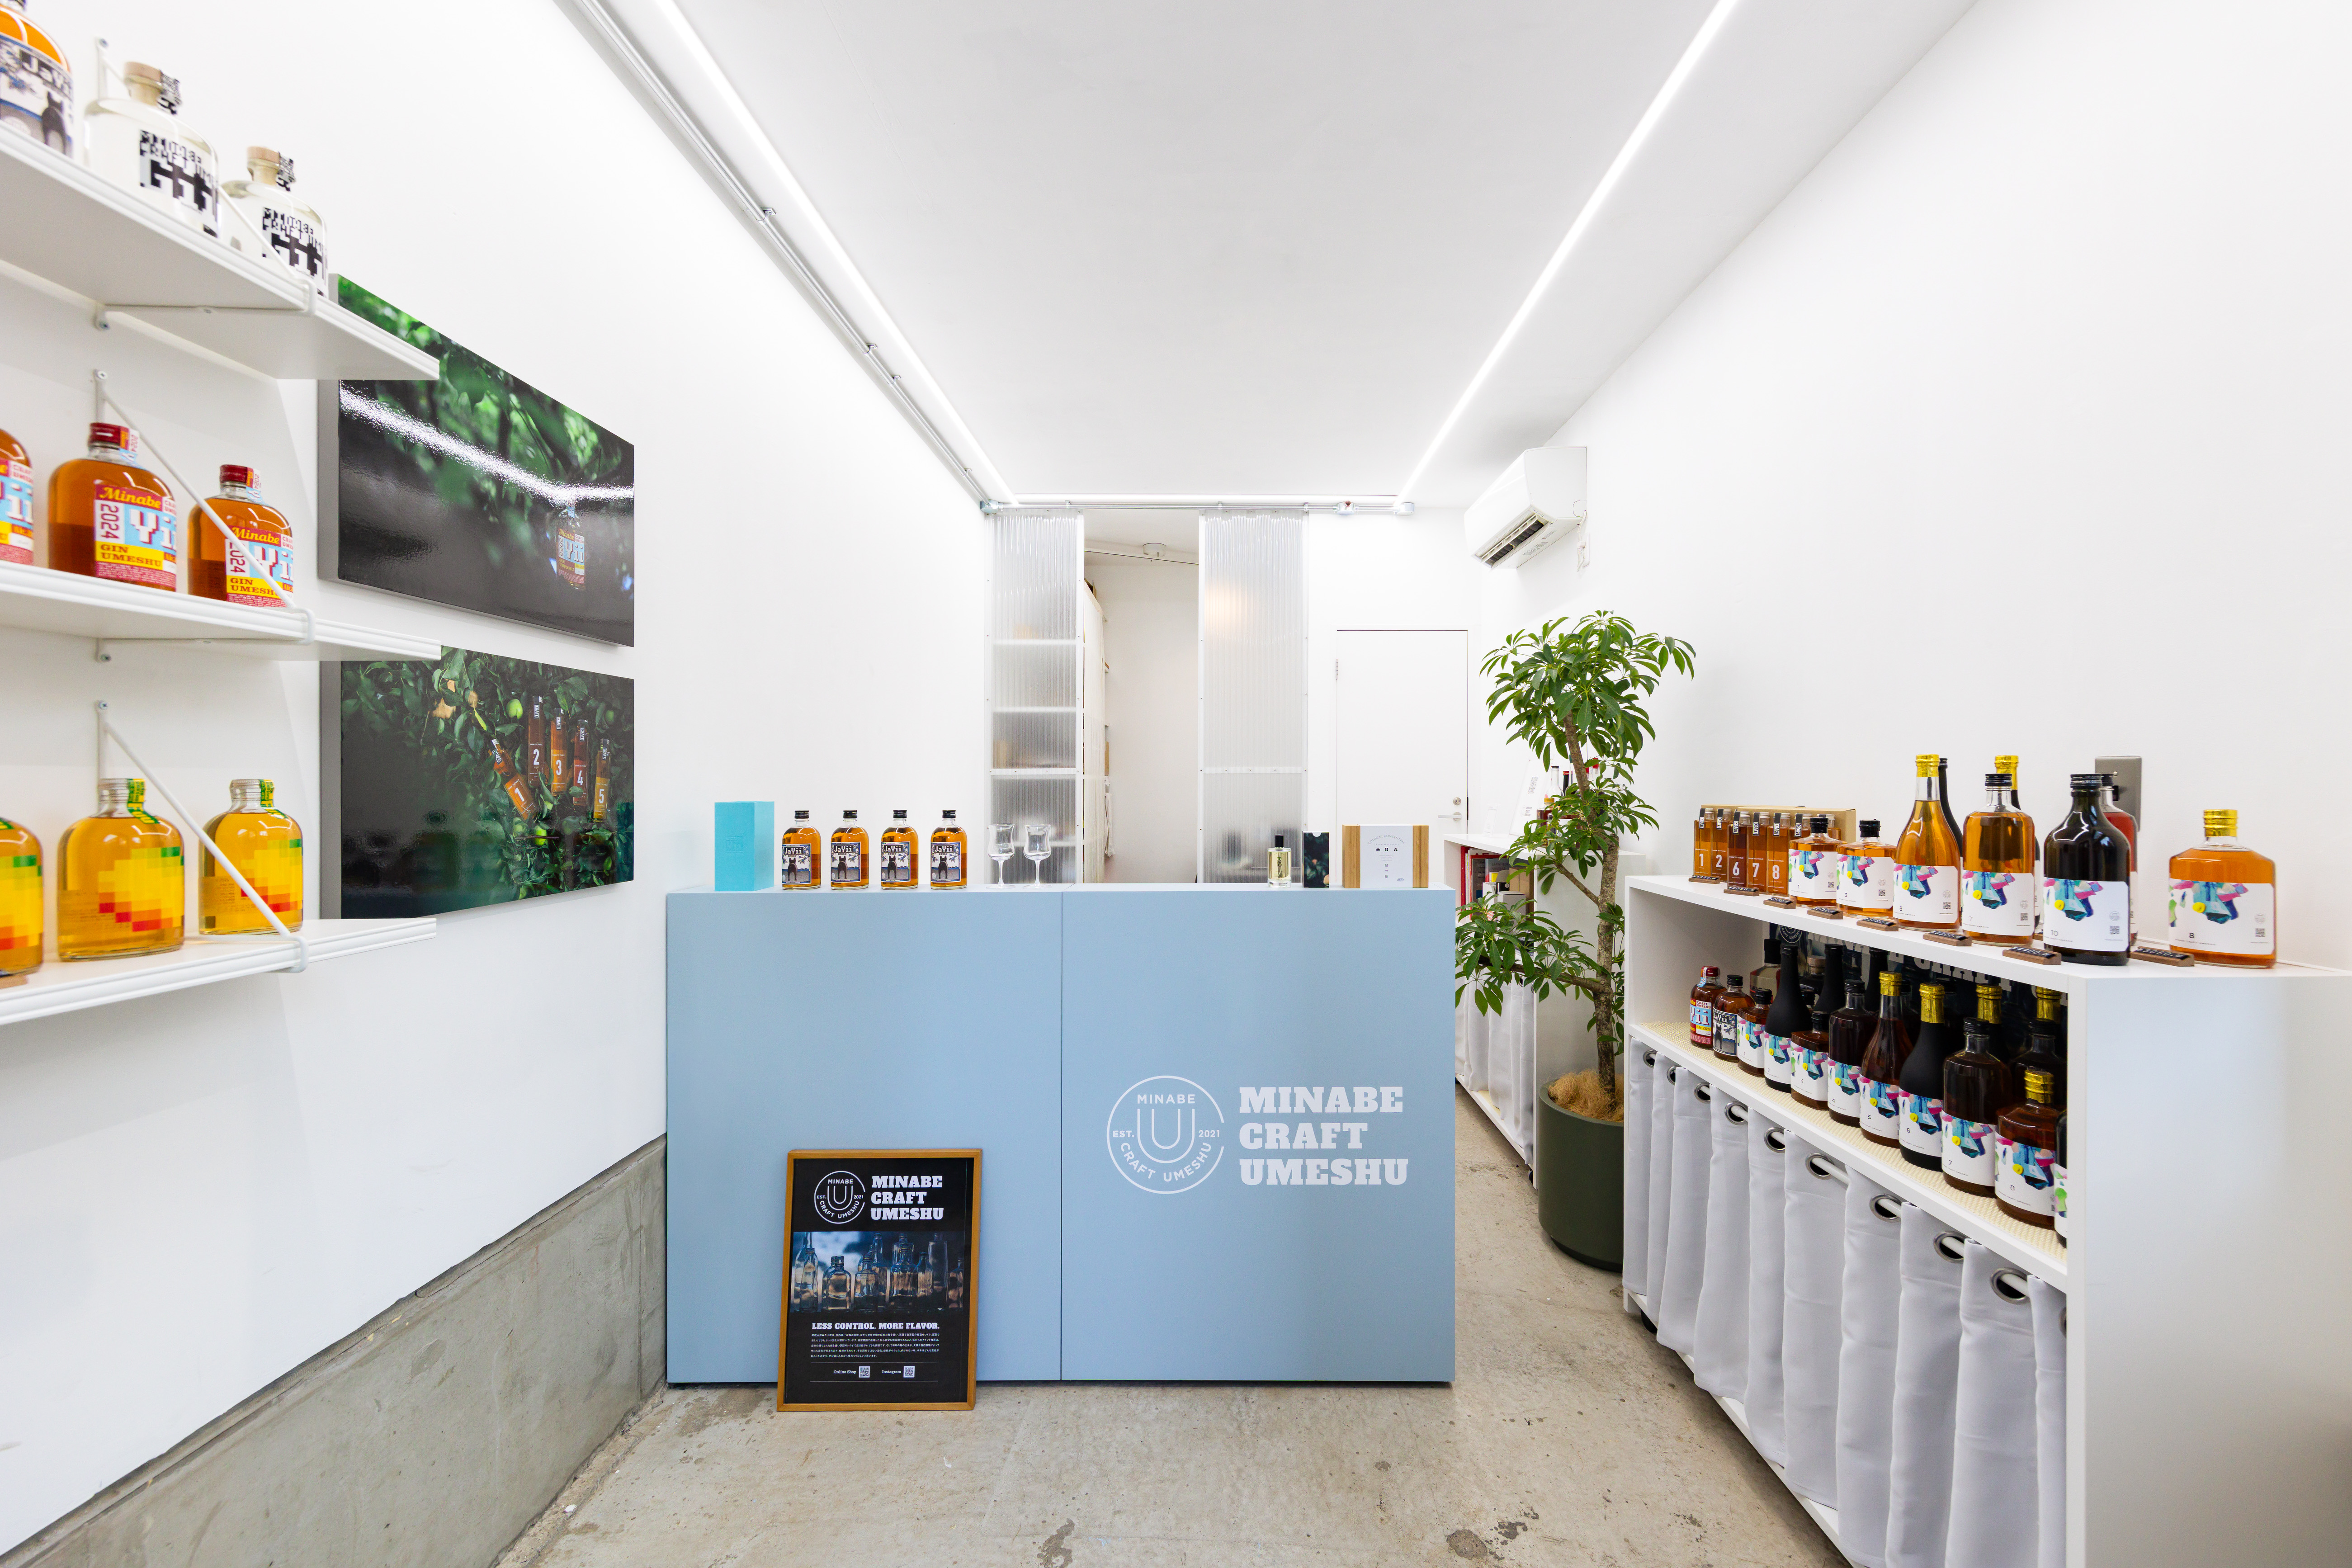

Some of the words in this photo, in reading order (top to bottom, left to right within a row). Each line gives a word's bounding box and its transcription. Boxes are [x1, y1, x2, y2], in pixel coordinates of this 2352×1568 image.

[99, 487, 161, 509] Minabe
[100, 504, 119, 539] 2024
[231, 526, 280, 545] Minabe
[101, 544, 128, 553] GIN
[565, 540, 584, 563] Yii
[101, 553, 162, 567] UMESHU
[533, 749, 539, 765] 2
[556, 760, 562, 775] 3
[577, 770, 583, 785] 4
[515, 788, 524, 802] 1
[599, 789, 604, 804] 5
[1699, 853, 1704, 866] 1
[1716, 855, 1722, 868] 2
[1733, 861, 1739, 876] 6
[1752, 863, 1759, 877] 7
[1772, 864, 1780, 880] 8
[1137, 1094, 1195, 1104] MINABE
[1239, 1086, 1403, 1113] MINABE
[1198, 1129, 1220, 1138] 2021
[1239, 1122, 1368, 1149] CRAFT
[1120, 1143, 1156, 1180] CRAFT
[1163, 1143, 1212, 1182] UMESHU
[1239, 1158, 1409, 1186] UMESHU
[872, 1176, 943, 1188] MINABE
[871, 1191, 927, 1204] CRAFT
[820, 1200, 835, 1218] CRAFT
[837, 1201, 860, 1219] UMESHU
[870, 1207, 944, 1220] UMESHU
